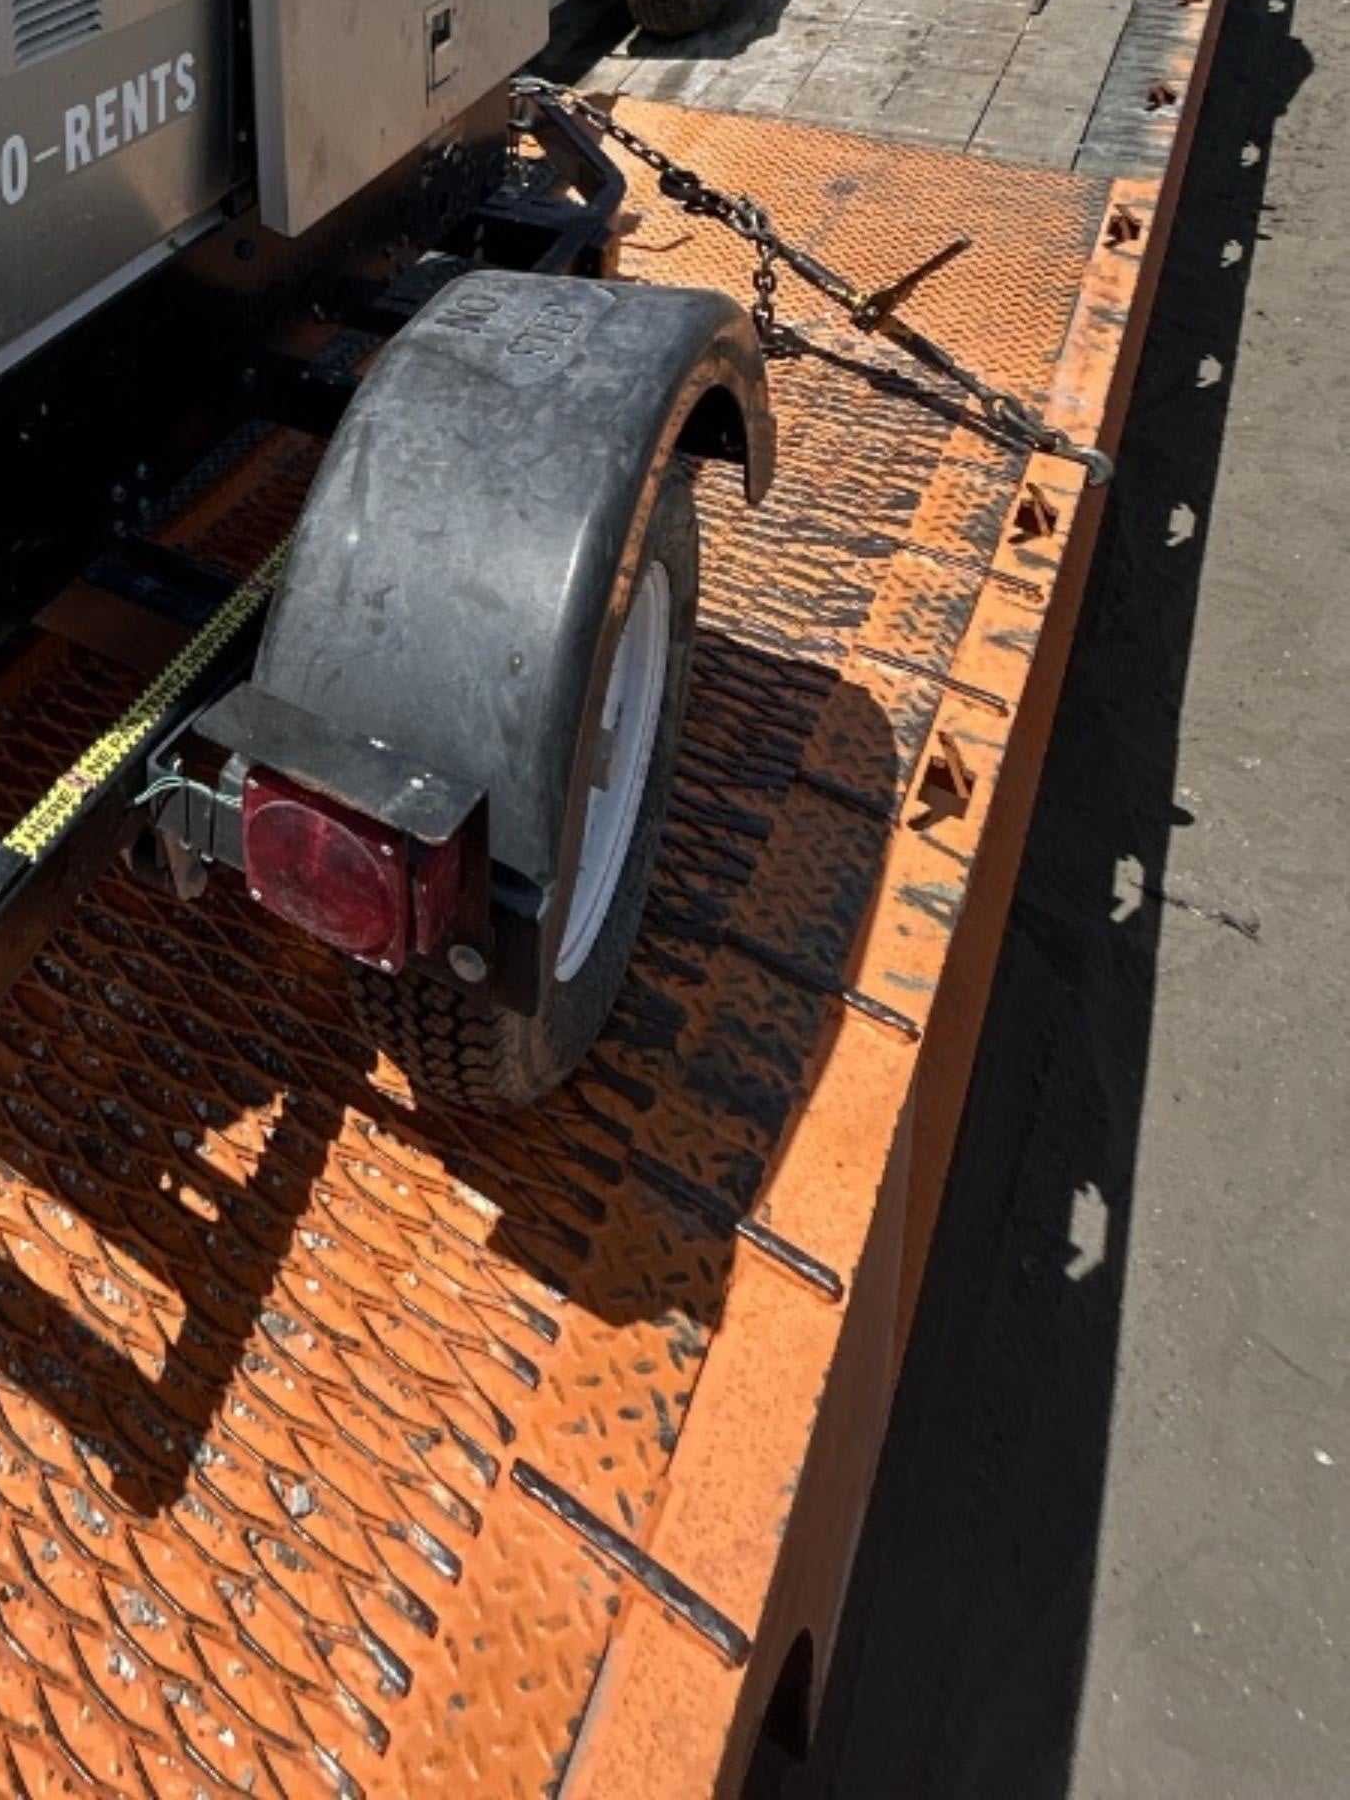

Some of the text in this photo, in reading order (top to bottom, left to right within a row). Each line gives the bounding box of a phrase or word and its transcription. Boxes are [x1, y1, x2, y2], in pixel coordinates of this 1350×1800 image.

[435, 295, 502, 333] NO
[506, 303, 583, 362] STEP
[22, 788, 76, 841] HERE
